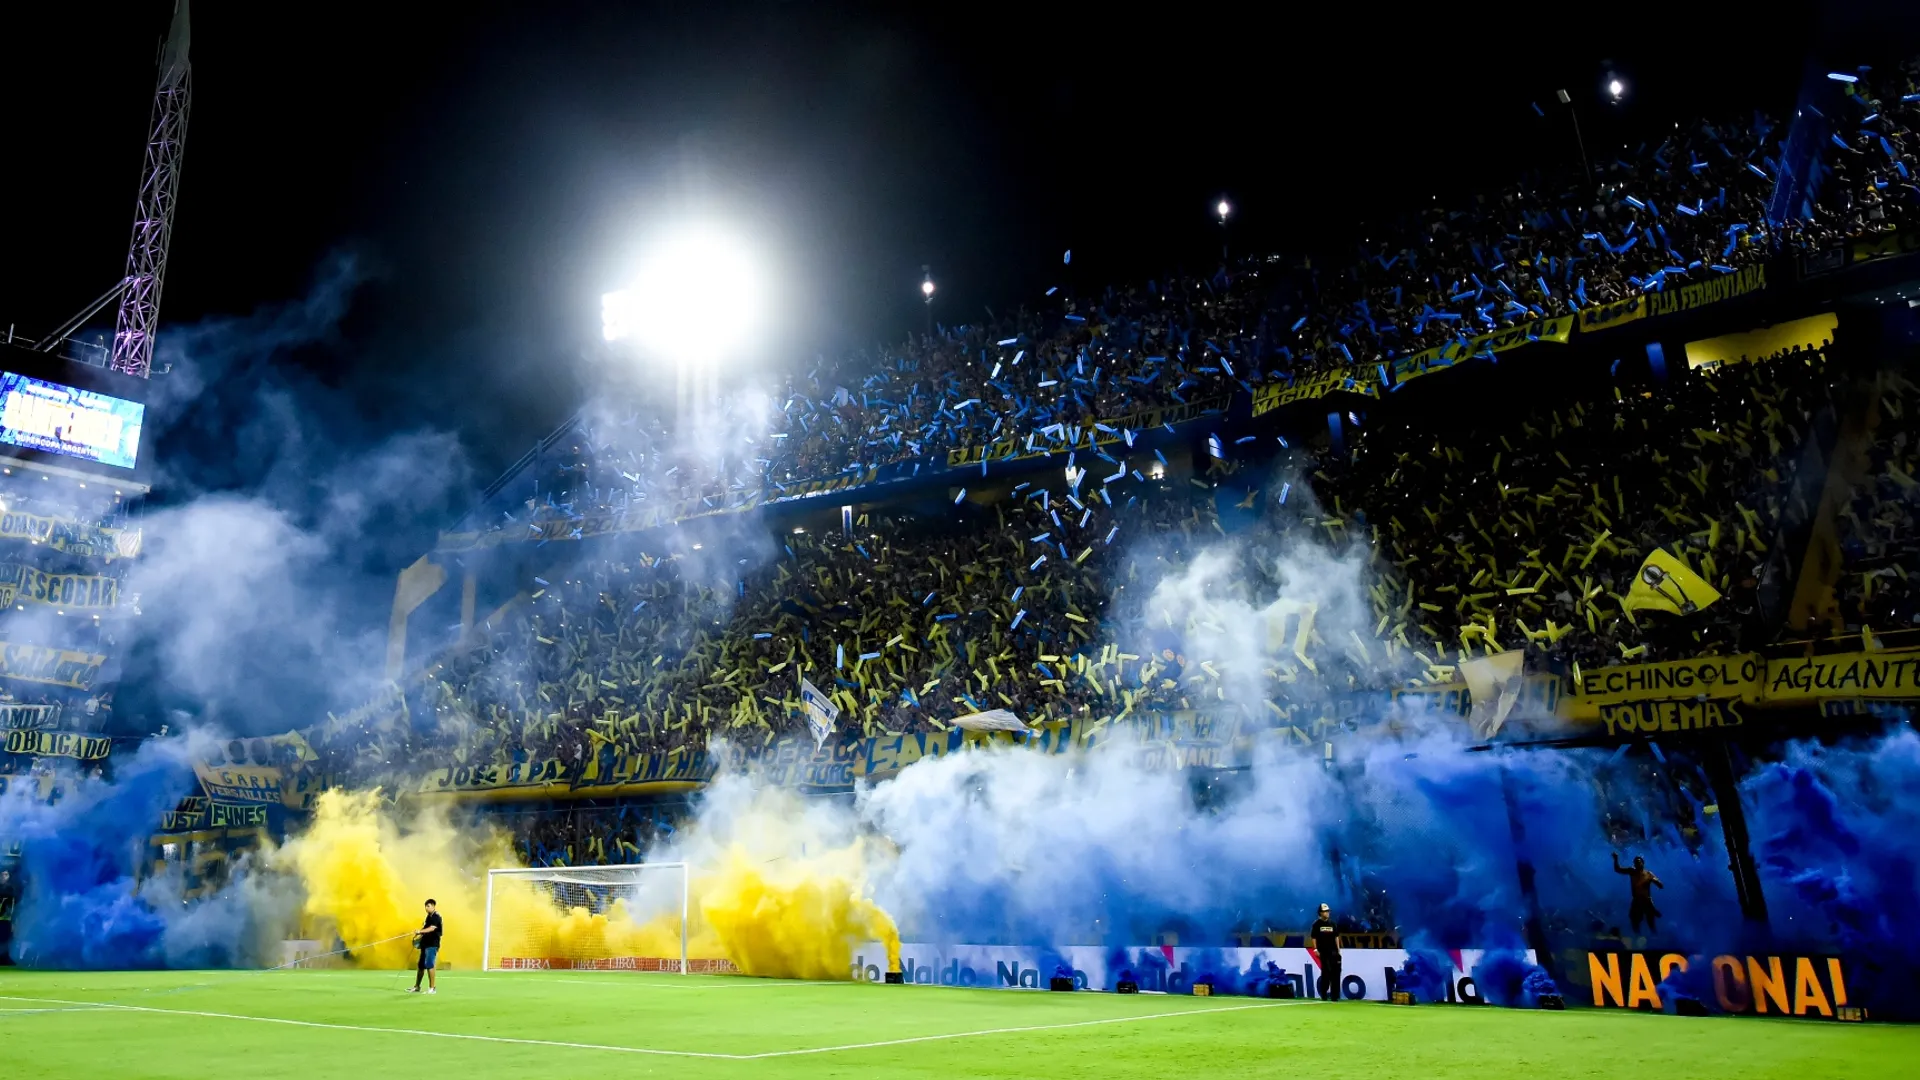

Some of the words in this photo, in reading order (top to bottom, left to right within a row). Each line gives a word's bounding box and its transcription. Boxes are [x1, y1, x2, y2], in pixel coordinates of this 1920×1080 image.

[1680, 263, 1766, 311] FERROVIARIA
[15, 434, 60, 450] SUPERCOPA
[61, 443, 101, 458] ARGENTIN
[20, 568, 114, 607] ESCOBAR
[207, 783, 281, 804] VERSAILLES
[213, 804, 267, 826] FUNES
[511, 957, 551, 970] LIBRA
[608, 956, 637, 970] LIBRA
[897, 957, 977, 986] Naldo
[995, 960, 1088, 989] Nao
[1587, 951, 1848, 1018] NACONAL
